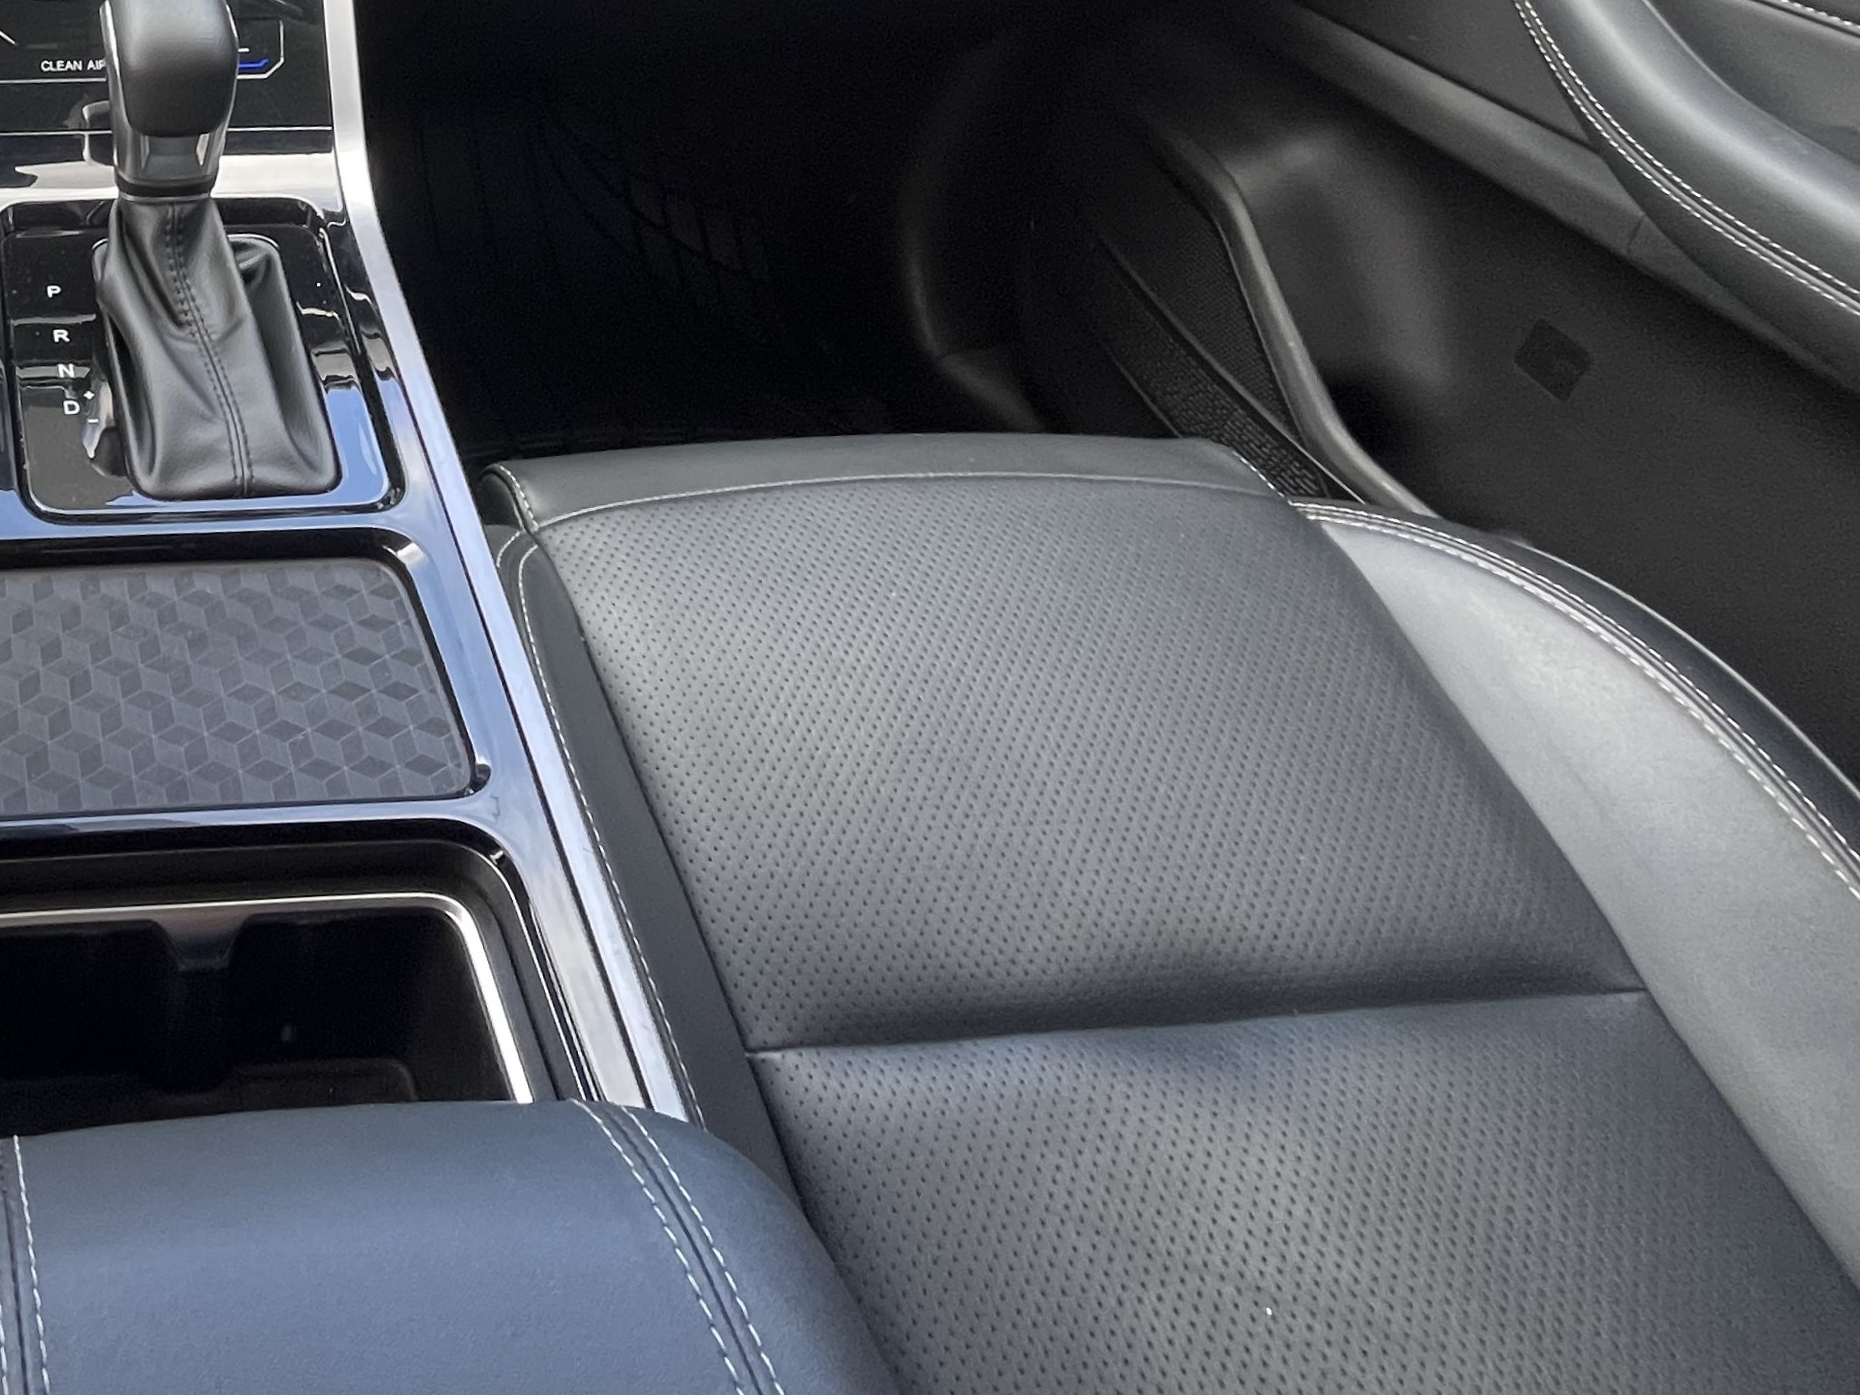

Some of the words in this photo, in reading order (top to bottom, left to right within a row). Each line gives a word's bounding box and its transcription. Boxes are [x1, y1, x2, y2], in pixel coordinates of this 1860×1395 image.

[40, 59, 83, 72] CLEAN
[46, 285, 62, 299] P
[52, 329, 71, 343] R
[57, 363, 76, 378] N
[62, 399, 81, 415] D
